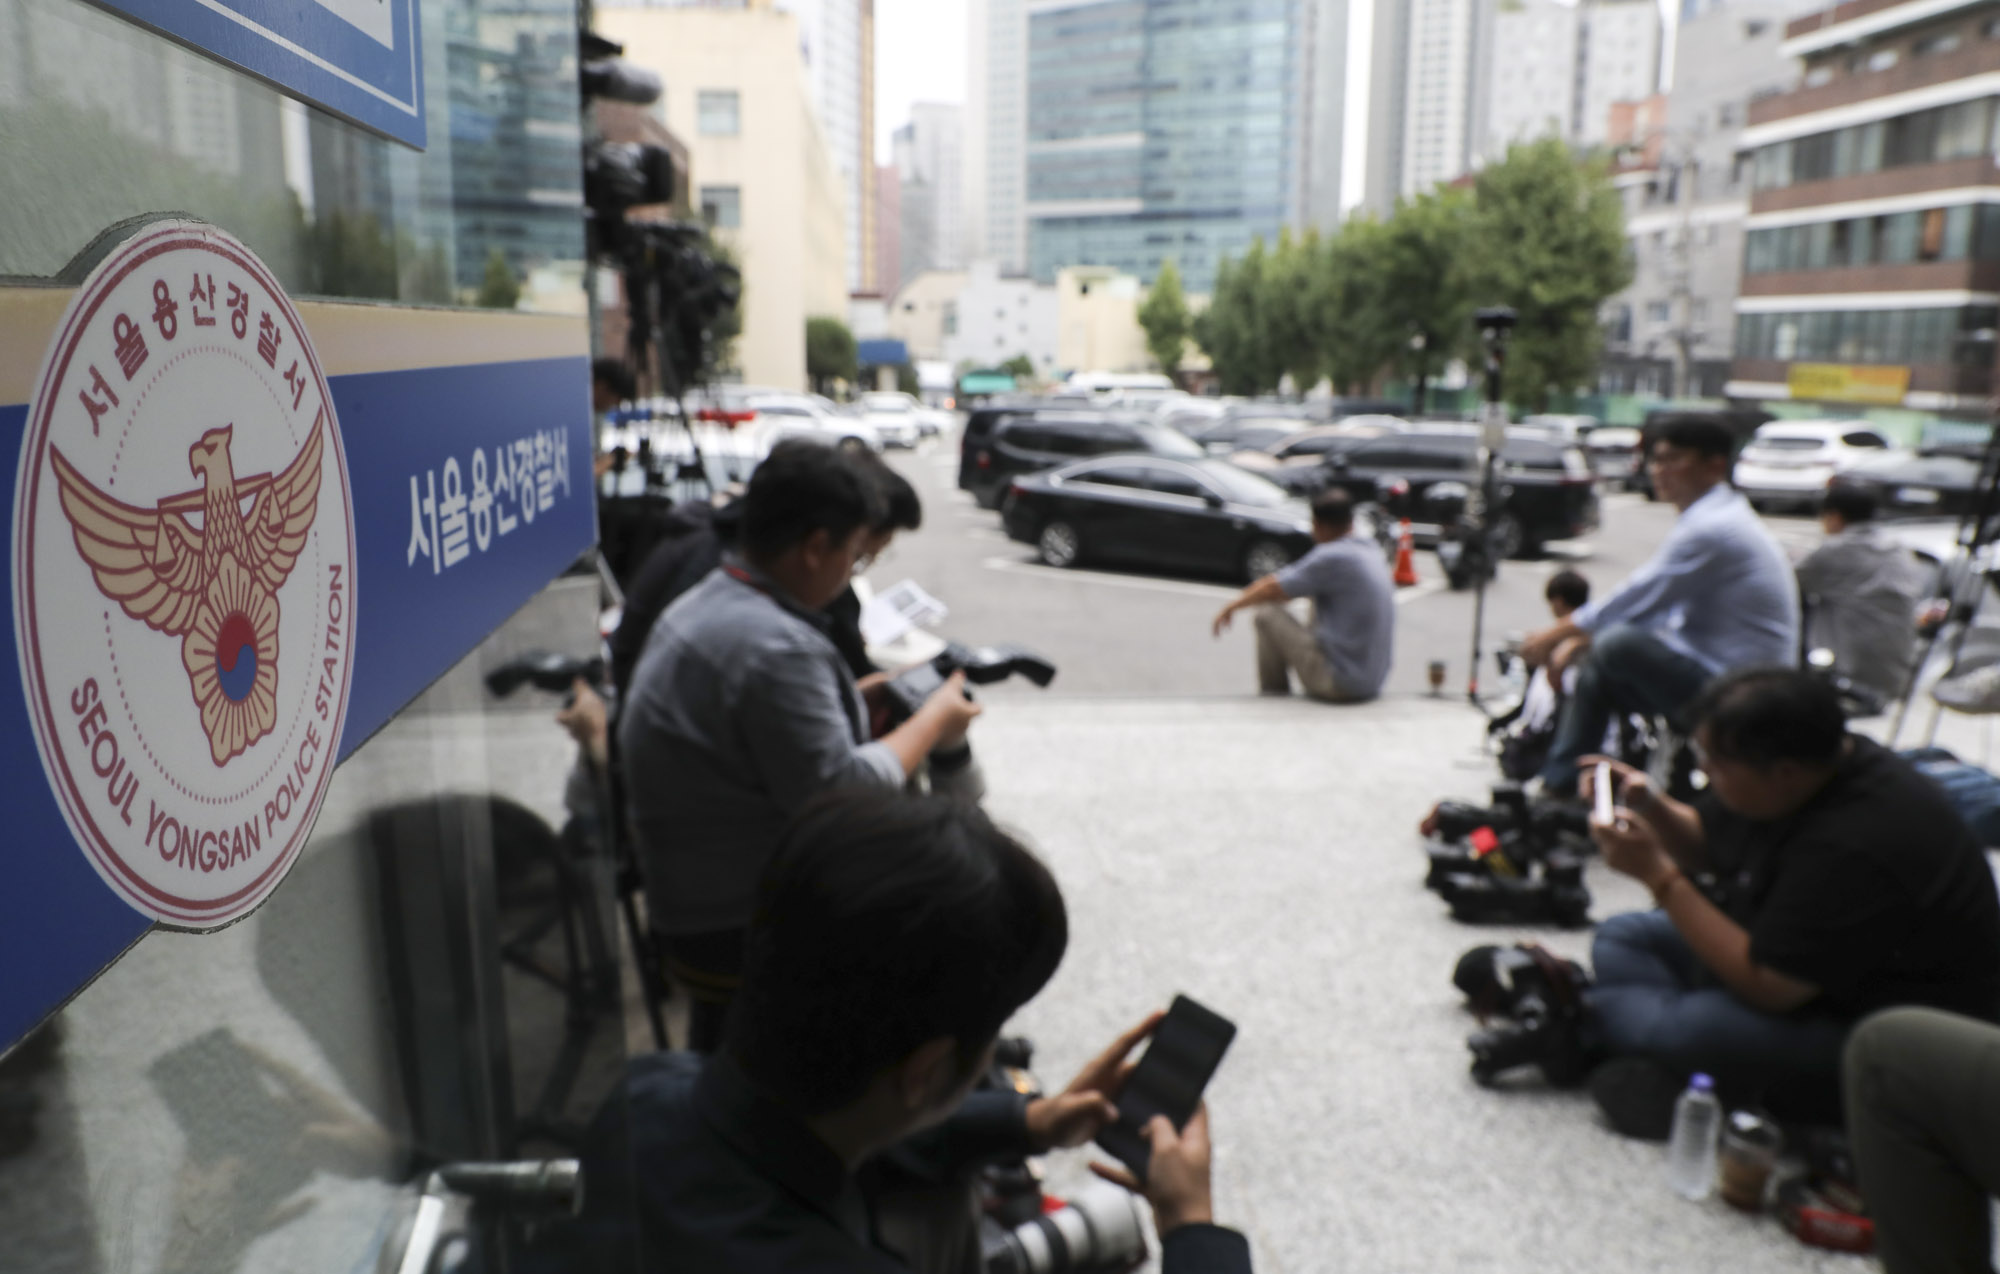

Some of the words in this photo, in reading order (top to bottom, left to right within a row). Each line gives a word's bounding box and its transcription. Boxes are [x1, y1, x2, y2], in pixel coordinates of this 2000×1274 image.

[80, 274, 306, 435] 서울용산경찰서
[407, 426, 571, 575] 서울용산경찰서
[71, 677, 139, 827] SEOUL
[145, 800, 261, 873] YONGSAN
[264, 720, 322, 839] POLICE
[314, 564, 343, 722] STATION
